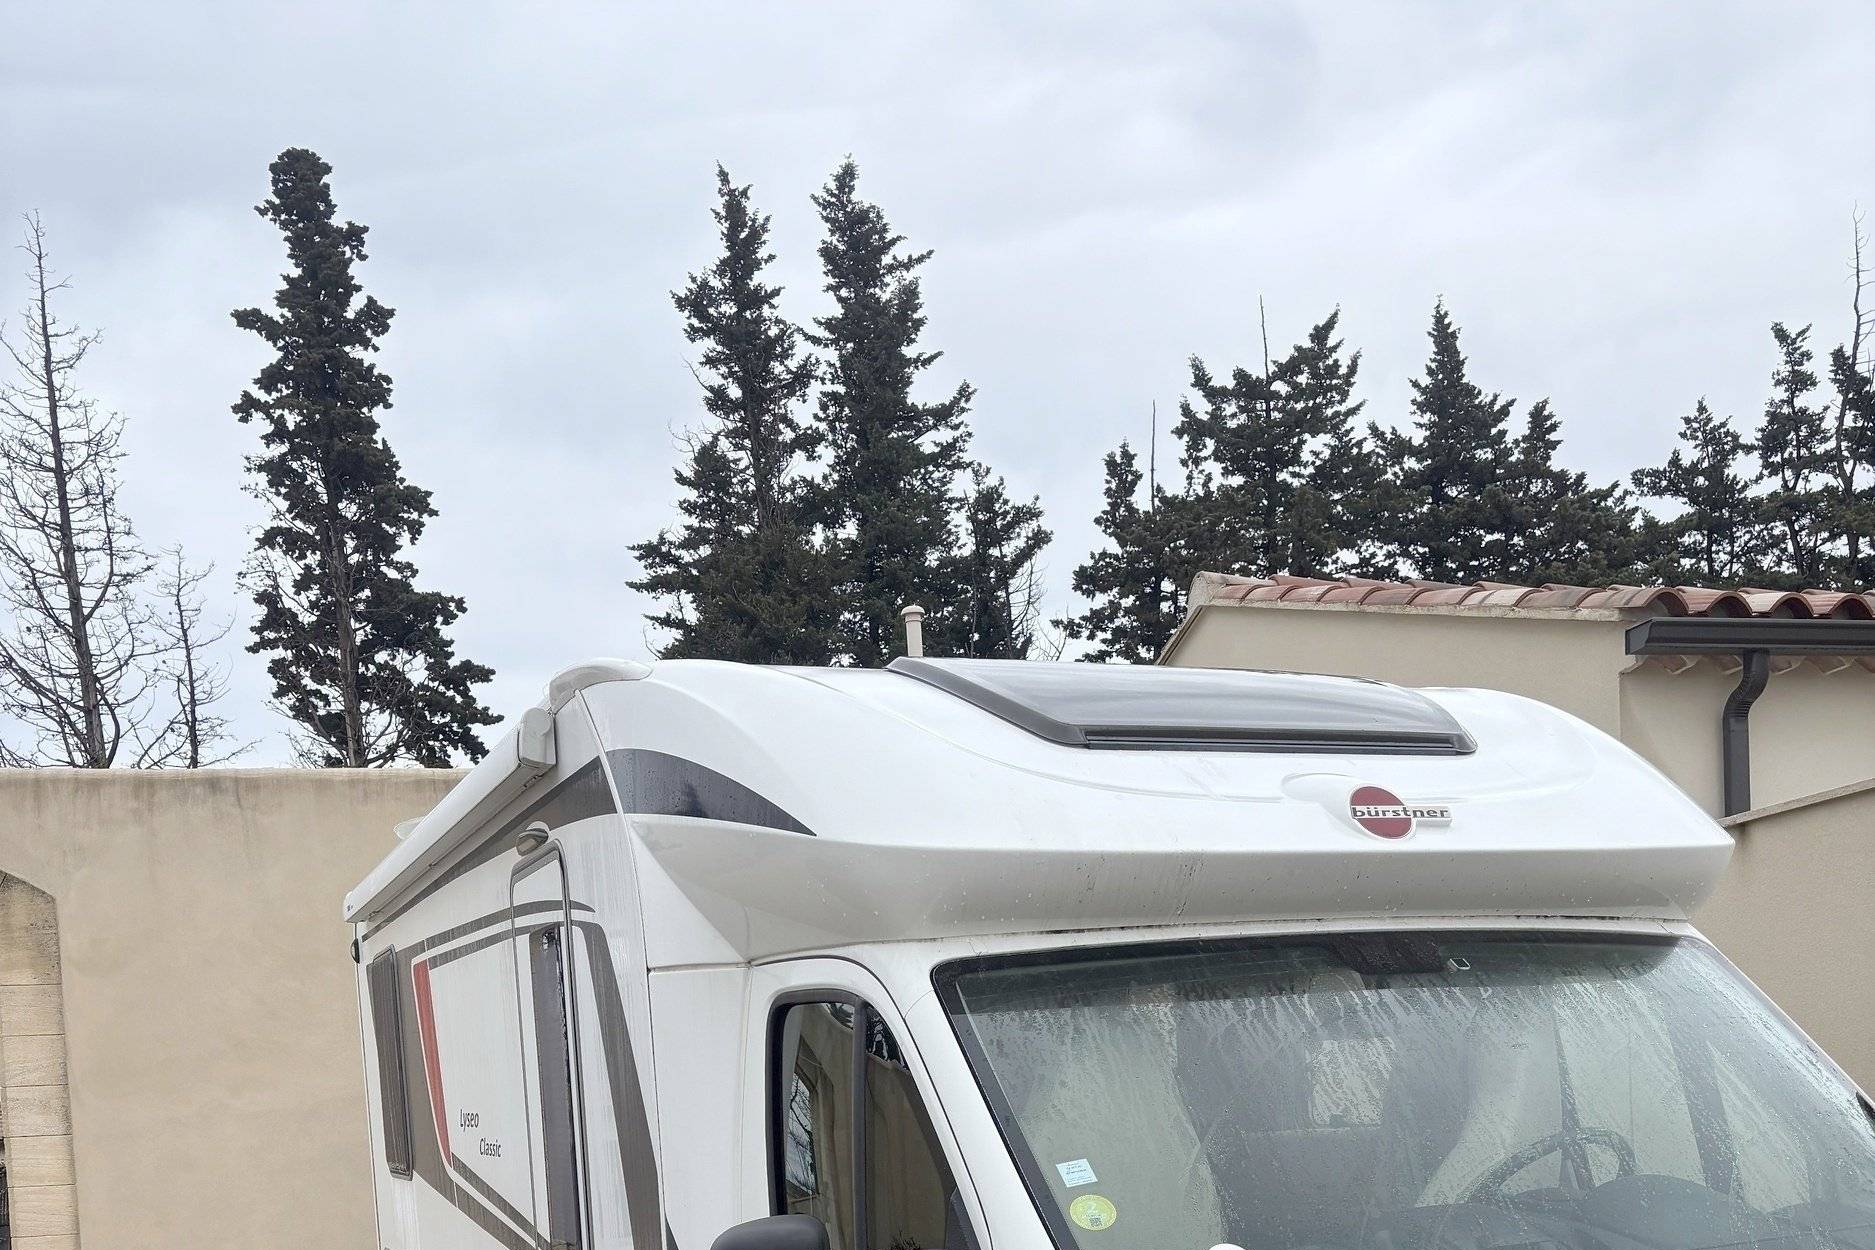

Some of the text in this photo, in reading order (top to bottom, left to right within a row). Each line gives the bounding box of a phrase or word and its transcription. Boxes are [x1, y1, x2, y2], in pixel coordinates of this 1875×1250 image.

[1351, 806, 1449, 818] bürstner
[459, 1108, 480, 1132] Lyseo
[479, 1137, 502, 1157] Classic
